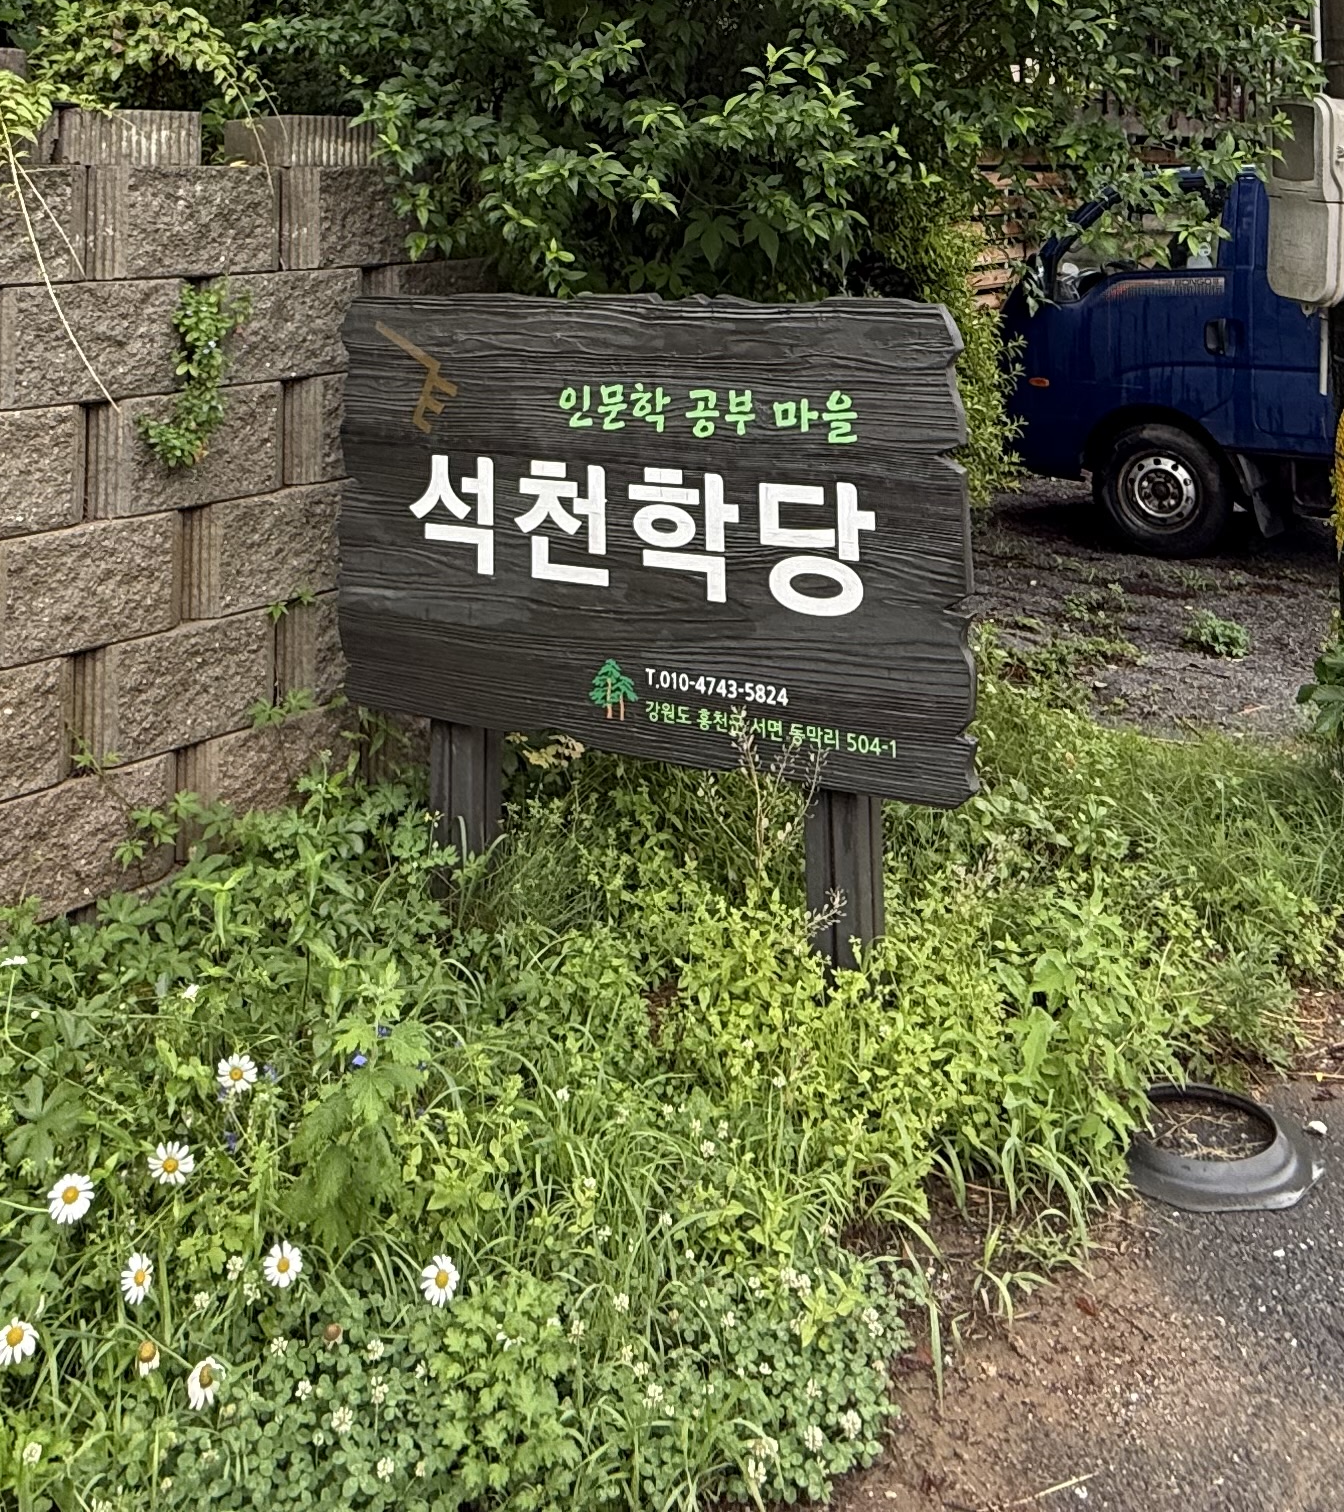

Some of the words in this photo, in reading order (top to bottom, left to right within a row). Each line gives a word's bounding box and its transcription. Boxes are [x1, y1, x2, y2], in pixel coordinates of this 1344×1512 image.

[558, 382, 672, 433] 인문학
[685, 388, 756, 438] 공부
[772, 389, 858, 444] 마을
[408, 454, 876, 617] 석천학당
[644, 667, 789, 707] T.010-4743-5824
[645, 700, 692, 725] 강원도
[750, 718, 783, 743] 서면
[789, 722, 840, 751] 동막리
[846, 732, 898, 759] 504-1
